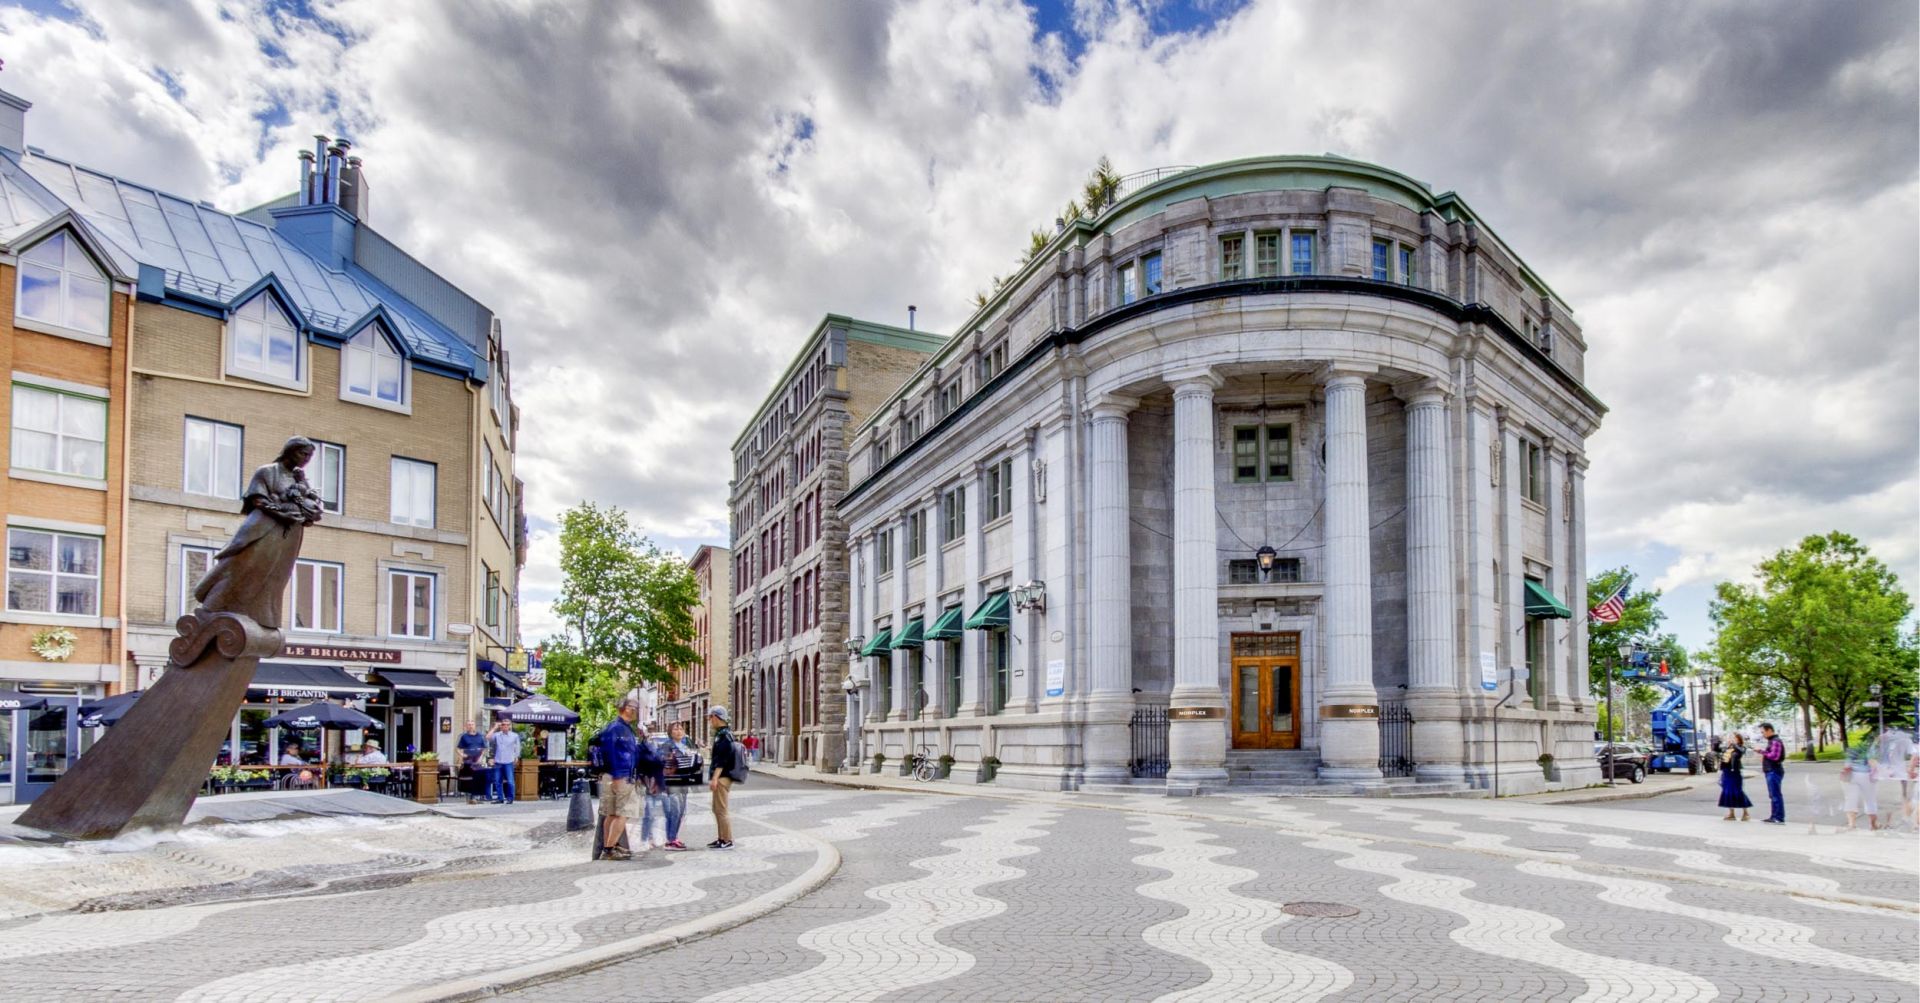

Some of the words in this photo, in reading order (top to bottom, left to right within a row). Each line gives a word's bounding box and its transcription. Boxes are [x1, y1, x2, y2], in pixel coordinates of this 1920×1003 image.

[286, 646, 304, 655] LE
[311, 648, 394, 660] BRIGANTIN
[280, 689, 328, 698] BRIGANTIN
